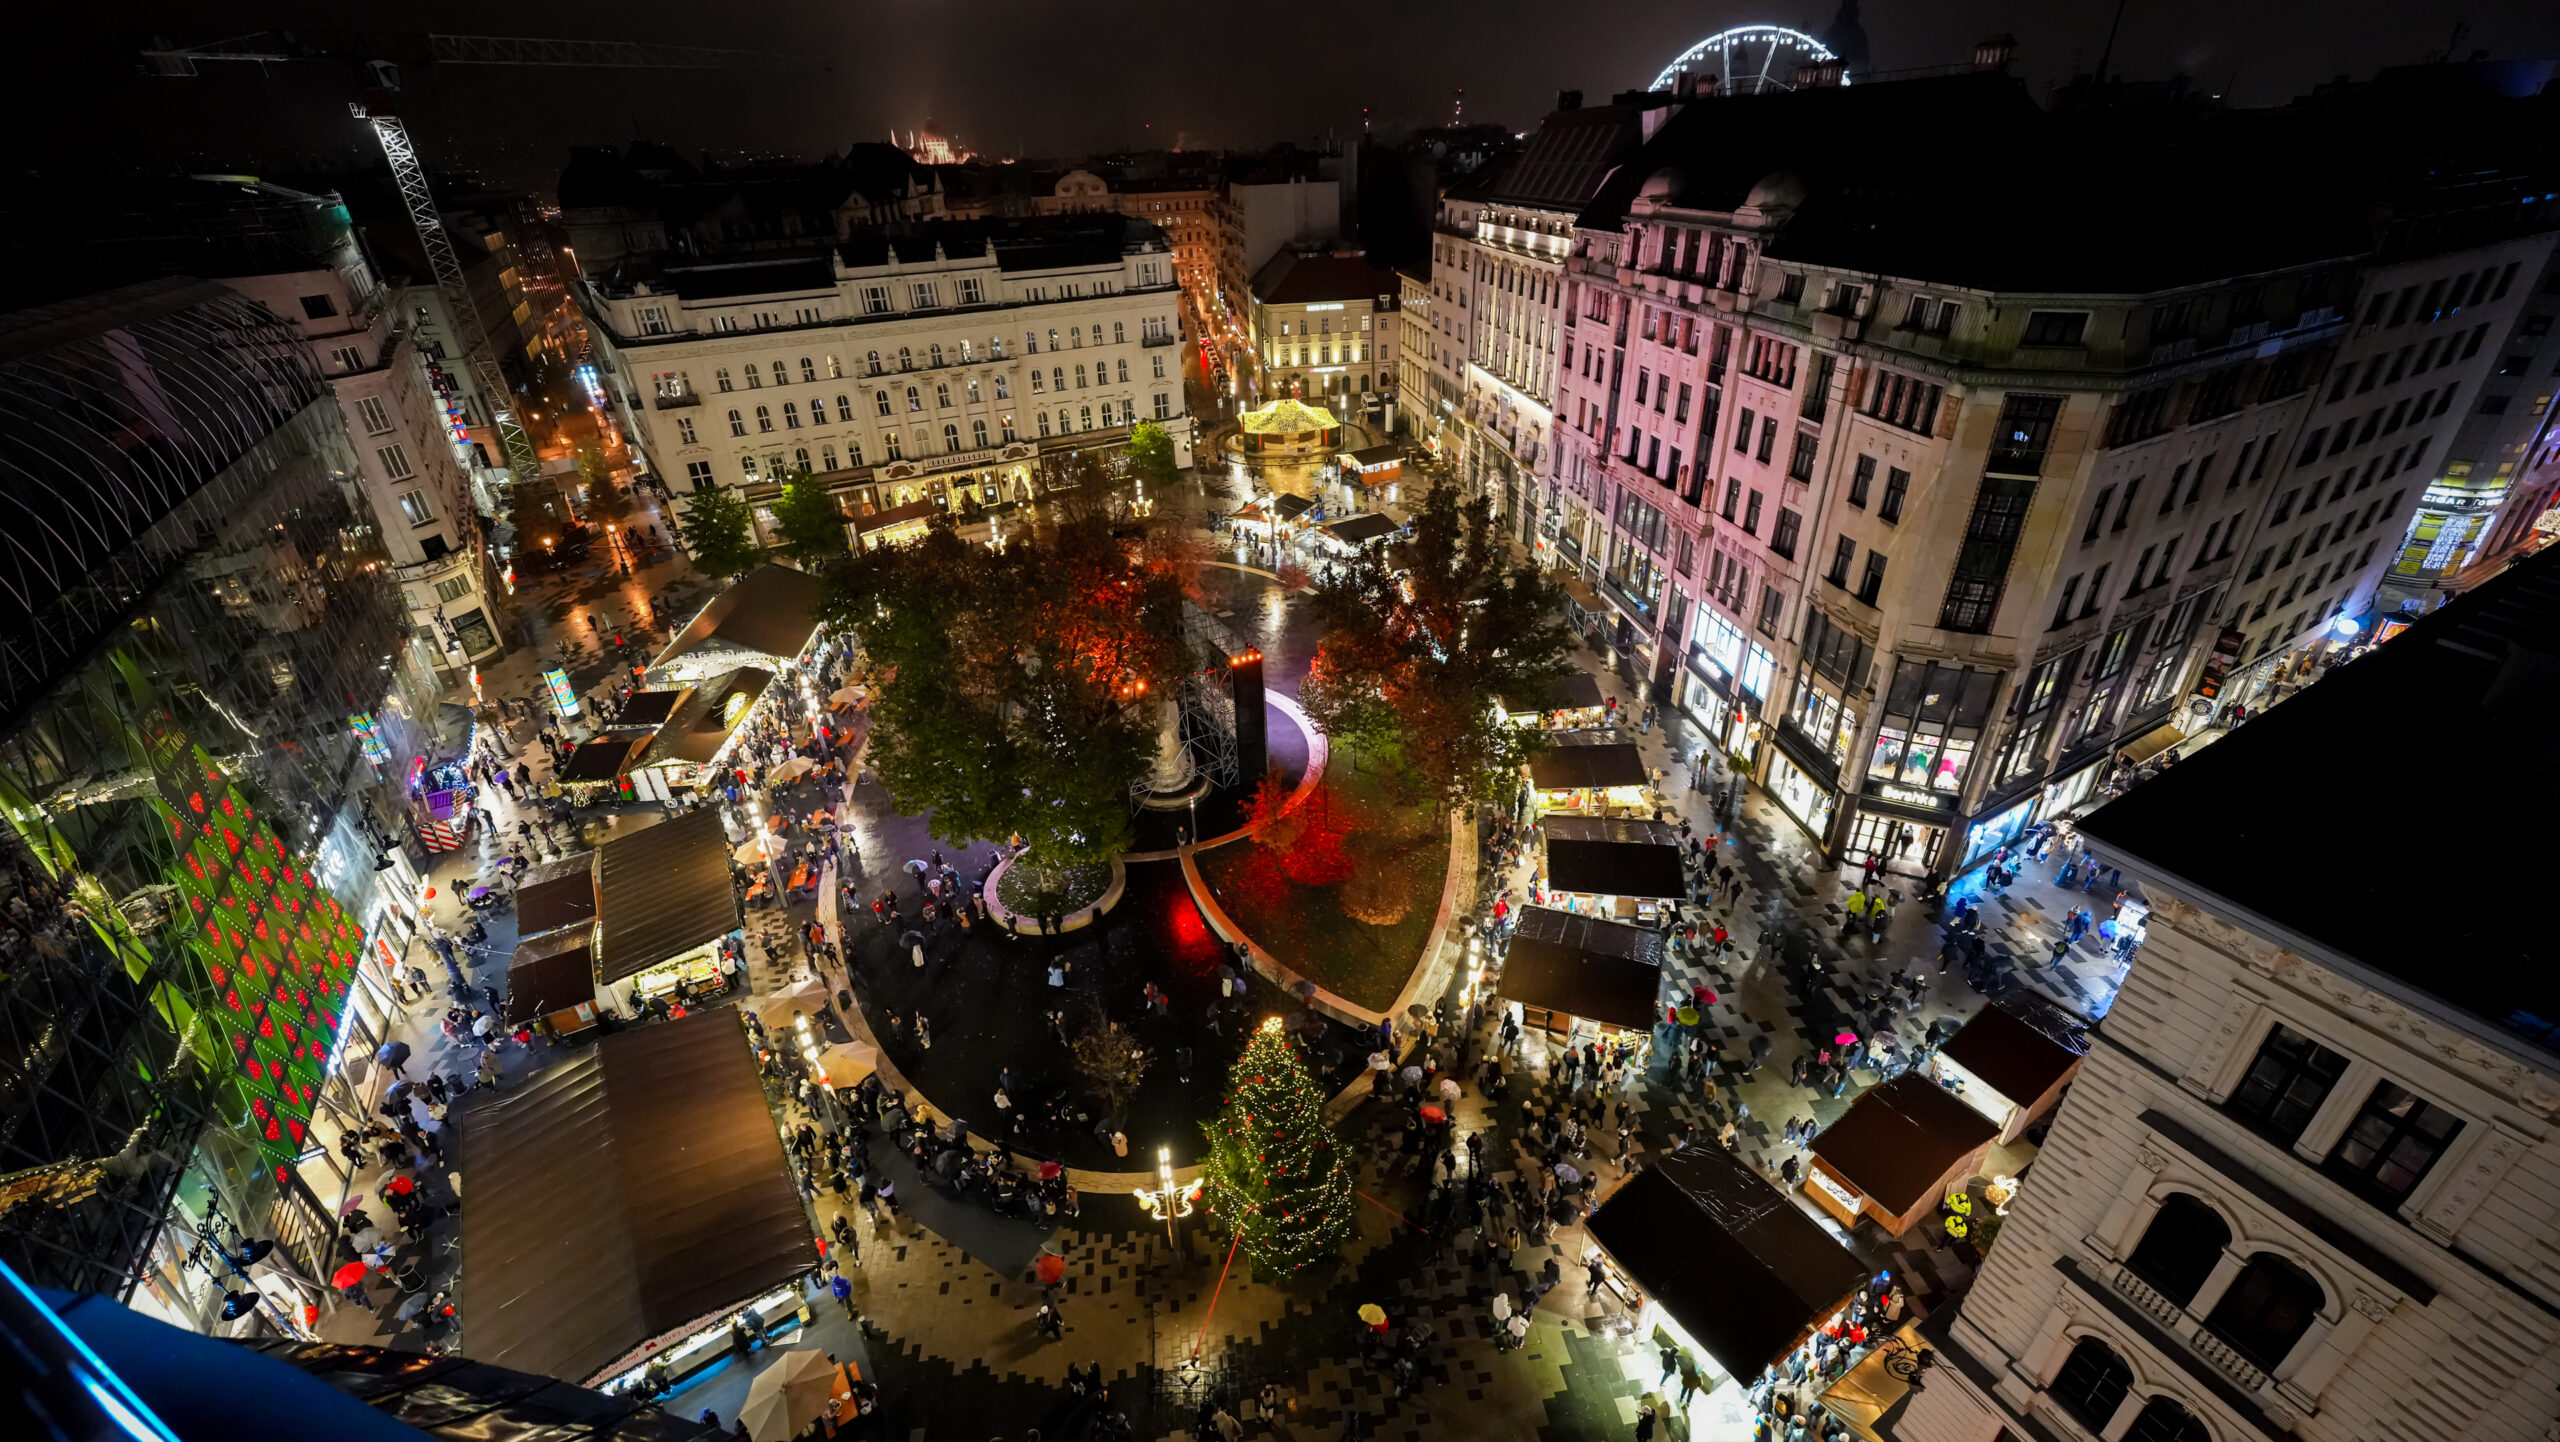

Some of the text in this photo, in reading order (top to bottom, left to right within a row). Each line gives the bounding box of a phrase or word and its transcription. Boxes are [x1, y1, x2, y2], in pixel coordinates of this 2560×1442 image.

[2421, 495, 2504, 506] CIGAR TOR
[1881, 785, 1938, 807] Bershka
